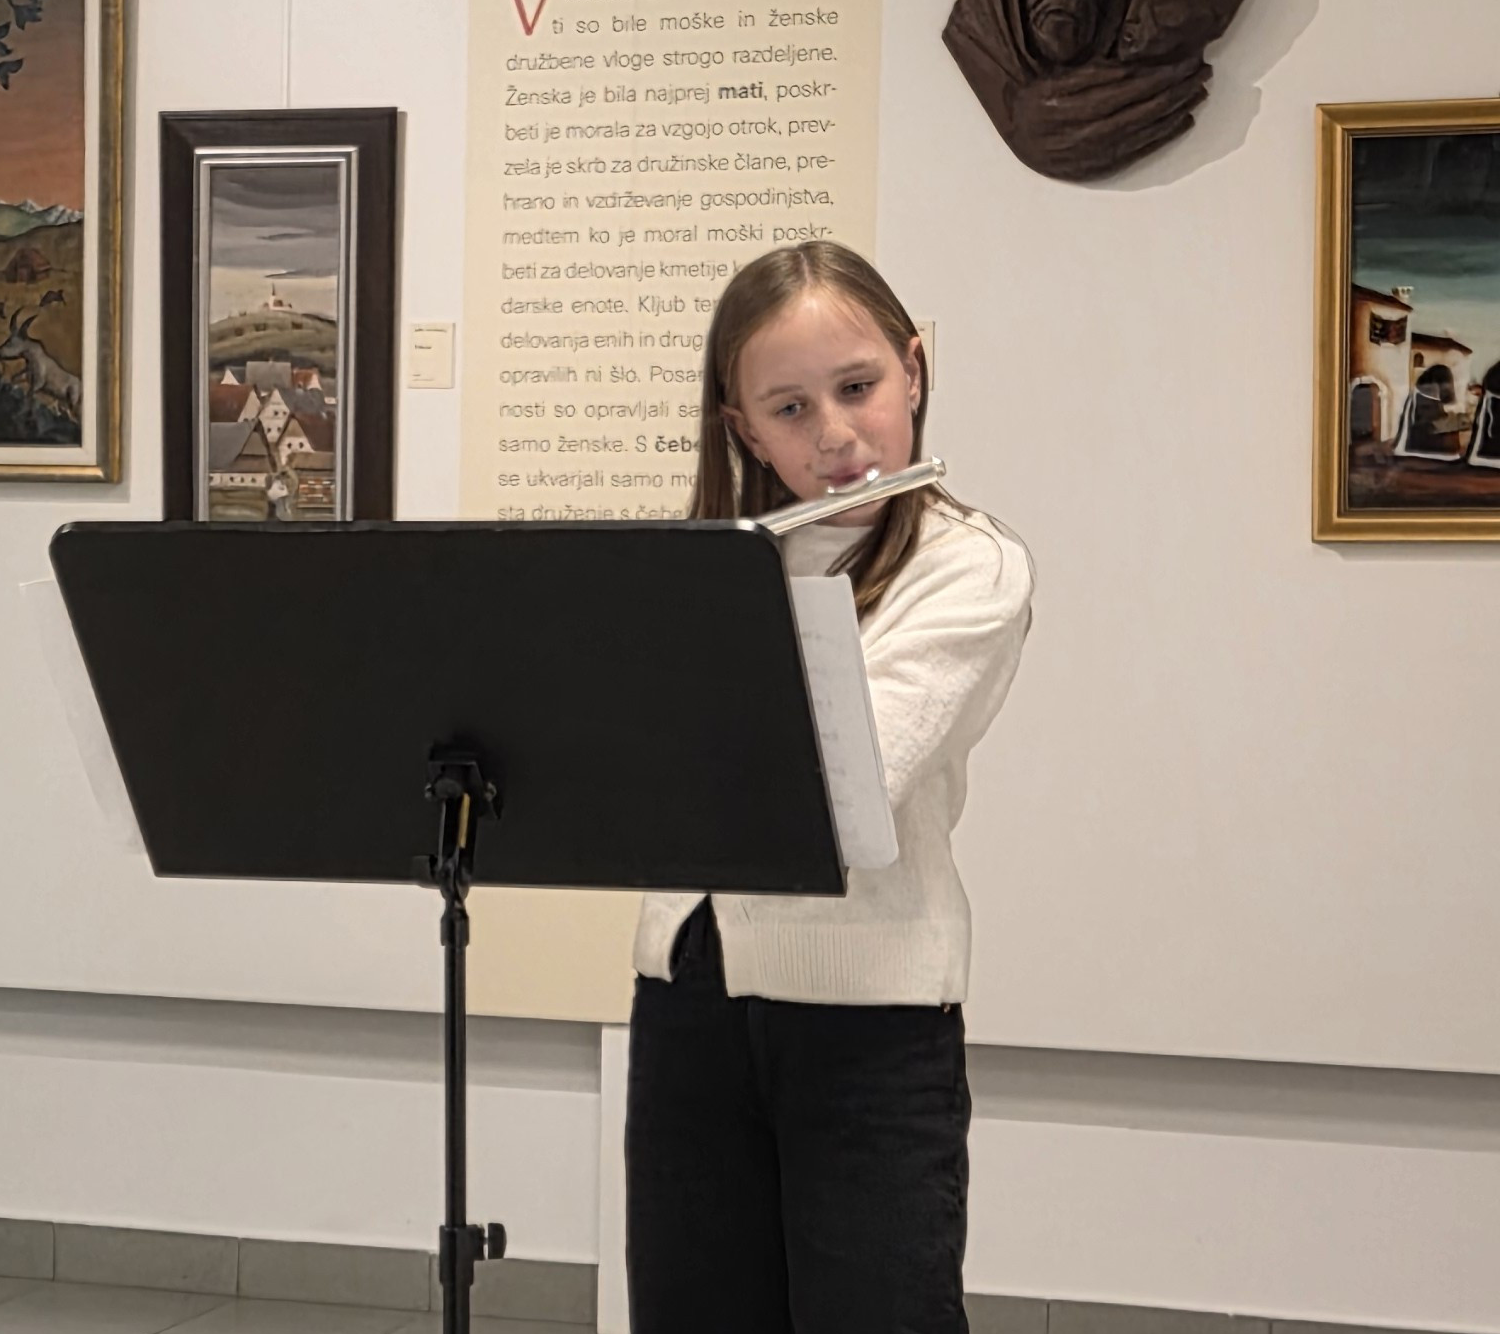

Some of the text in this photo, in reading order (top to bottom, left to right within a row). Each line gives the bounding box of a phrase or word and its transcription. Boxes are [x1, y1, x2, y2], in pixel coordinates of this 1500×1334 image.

[576, 20, 599, 33] so
[612, 15, 647, 32] bile
[660, 12, 725, 31] moške
[738, 10, 755, 27] in
[768, 7, 839, 27] ženske
[506, 44, 838, 71] družbene vloge strogo razdeljene.
[505, 80, 838, 108] Ženska je bila najprej mati, poskr-
[505, 117, 836, 144] beti je morala za vzgojo otrok, prev-
[504, 153, 836, 178] zela je skrb za družinske člane, pre-
[503, 188, 834, 211] hrano in vzdrževanje gospodinjstva,
[503, 222, 833, 247] medtem ko je moral moški poskr-
[502, 262, 537, 279] beti
[540, 266, 561, 279] za
[565, 261, 655, 281] delovanje
[659, 261, 728, 281] kmetije
[501, 297, 563, 314] darske
[571, 299, 629, 313] enote.
[638, 295, 686, 316] Kljub
[500, 331, 589, 352] delovanja
[594, 332, 634, 348] enih
[639, 331, 655, 347] in
[500, 367, 578, 386] opravilih
[585, 366, 602, 383] ni
[609, 366, 641, 383] šlo.
[499, 401, 545, 417] nosti
[554, 404, 575, 417] so
[584, 400, 669, 421] opravljali
[499, 437, 551, 452] samo
[557, 435, 628, 452] ženske.
[635, 435, 647, 452] S
[498, 473, 520, 487] se
[526, 470, 604, 490] ukvarjali
[611, 473, 663, 487] samo
